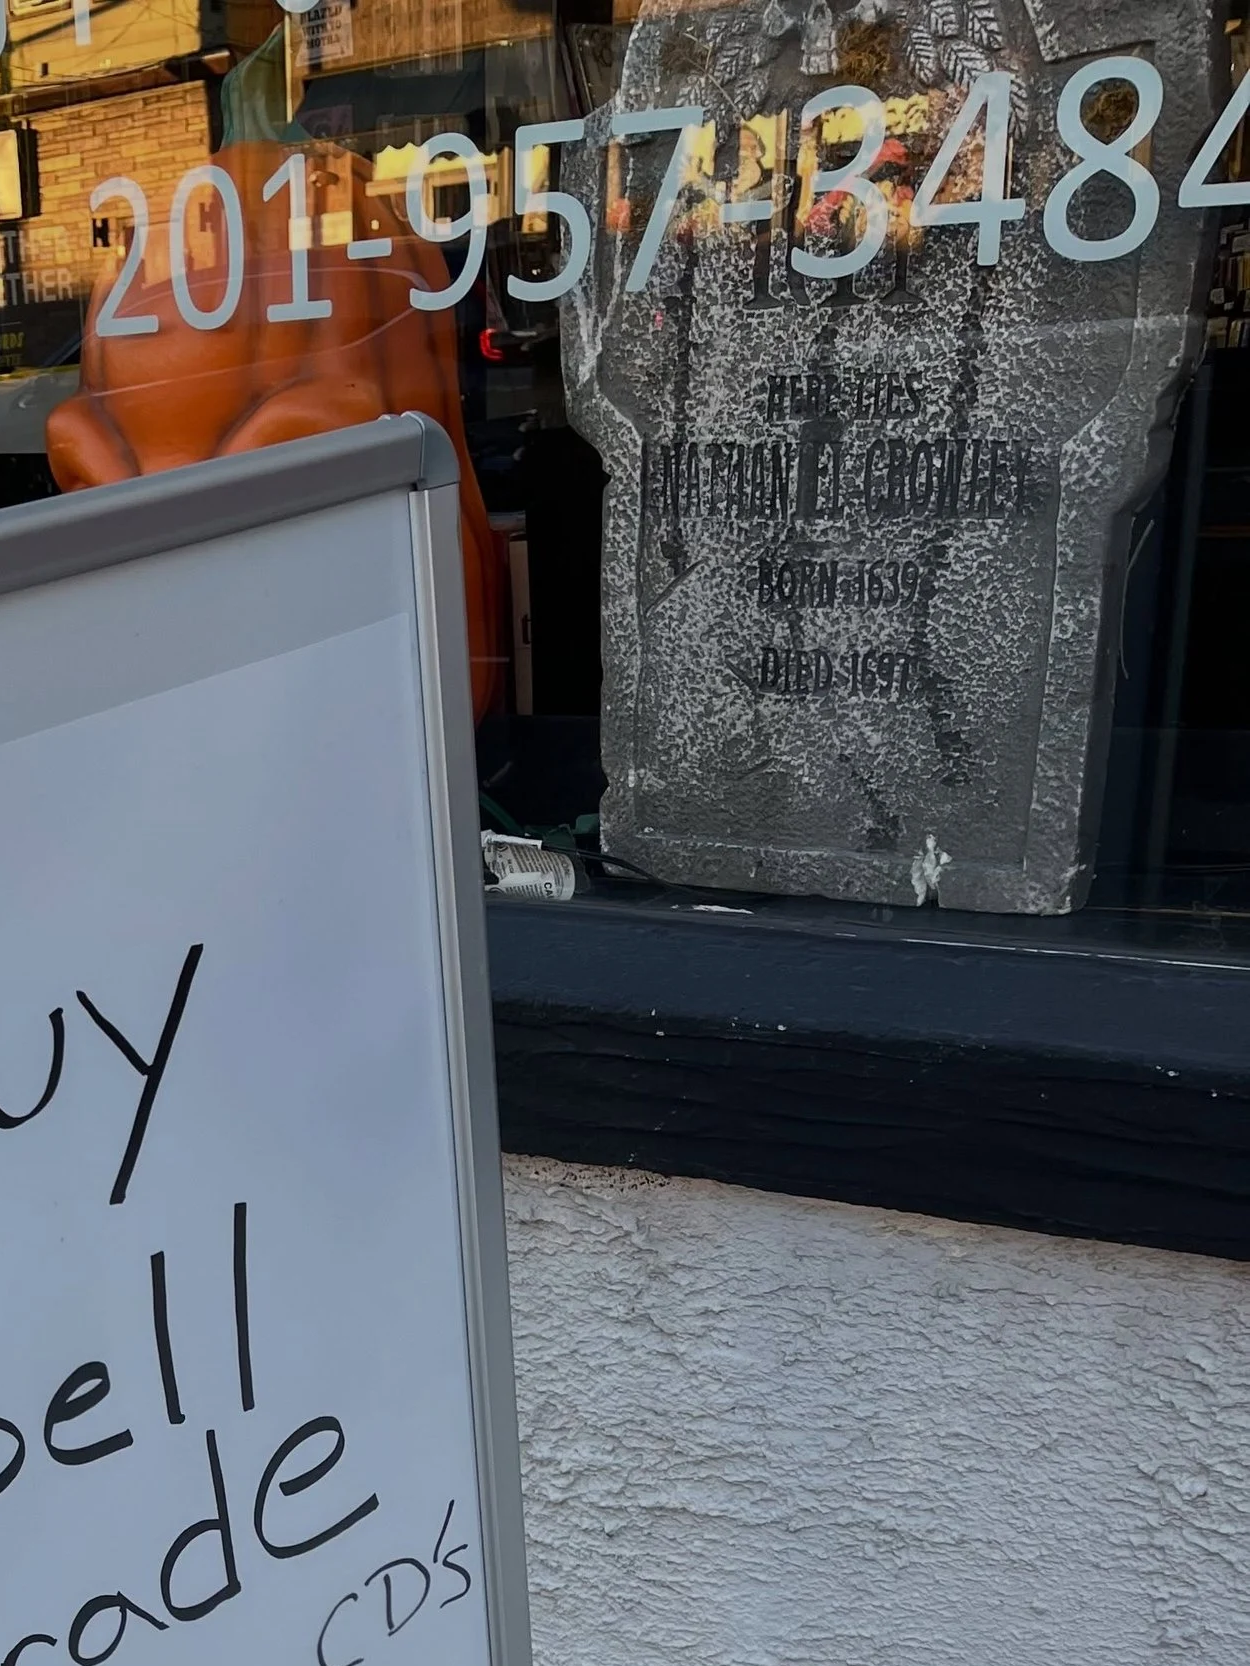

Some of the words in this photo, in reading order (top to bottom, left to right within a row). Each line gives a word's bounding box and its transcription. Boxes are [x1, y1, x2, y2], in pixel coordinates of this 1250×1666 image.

[853, 372, 925, 420] LIES
[758, 559, 839, 608] BORN
[758, 648, 833, 697] DIED
